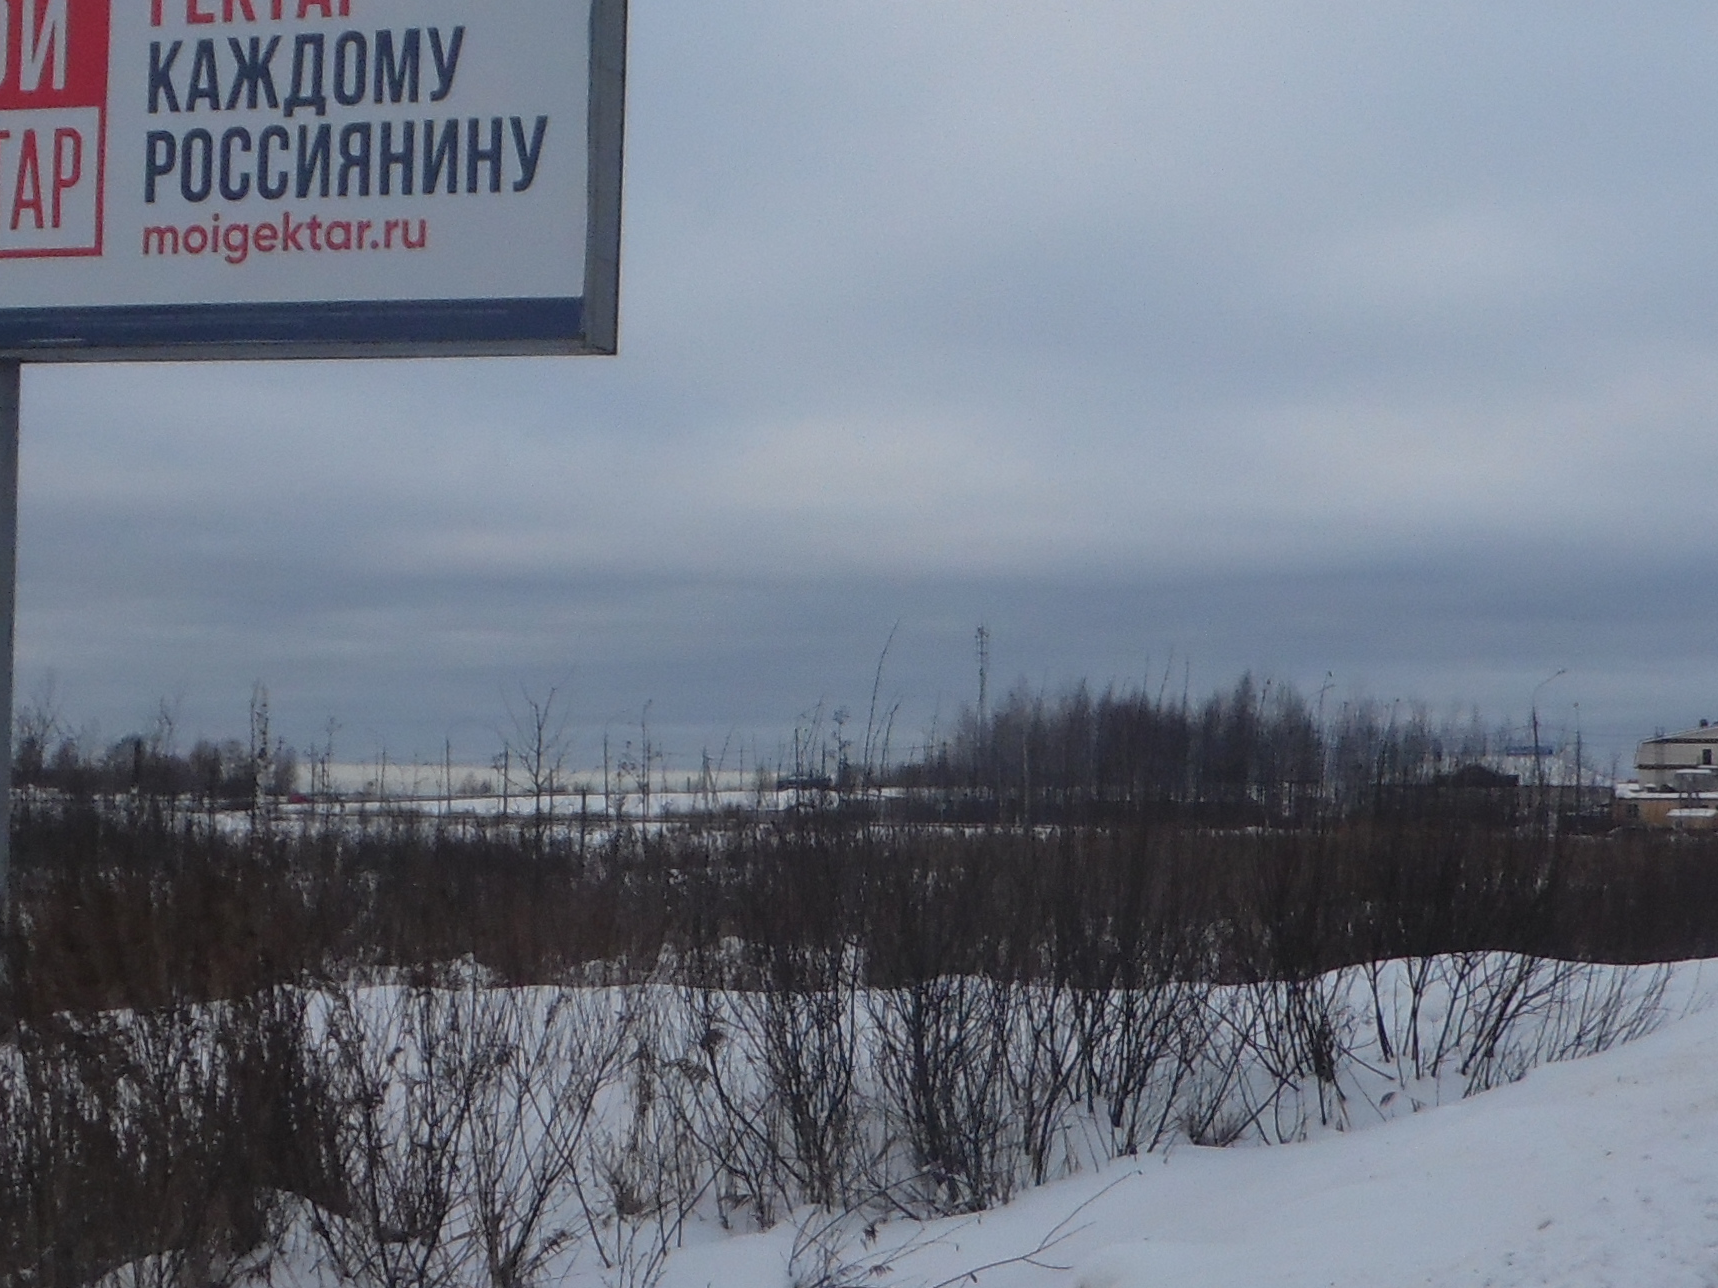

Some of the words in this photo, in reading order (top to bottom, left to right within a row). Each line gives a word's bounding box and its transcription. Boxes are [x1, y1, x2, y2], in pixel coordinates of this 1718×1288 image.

[147, 25, 466, 117] КАЖДОМУ
[144, 115, 549, 205] РОССИЯНИНУ
[143, 212, 428, 266] moigektar.ru
